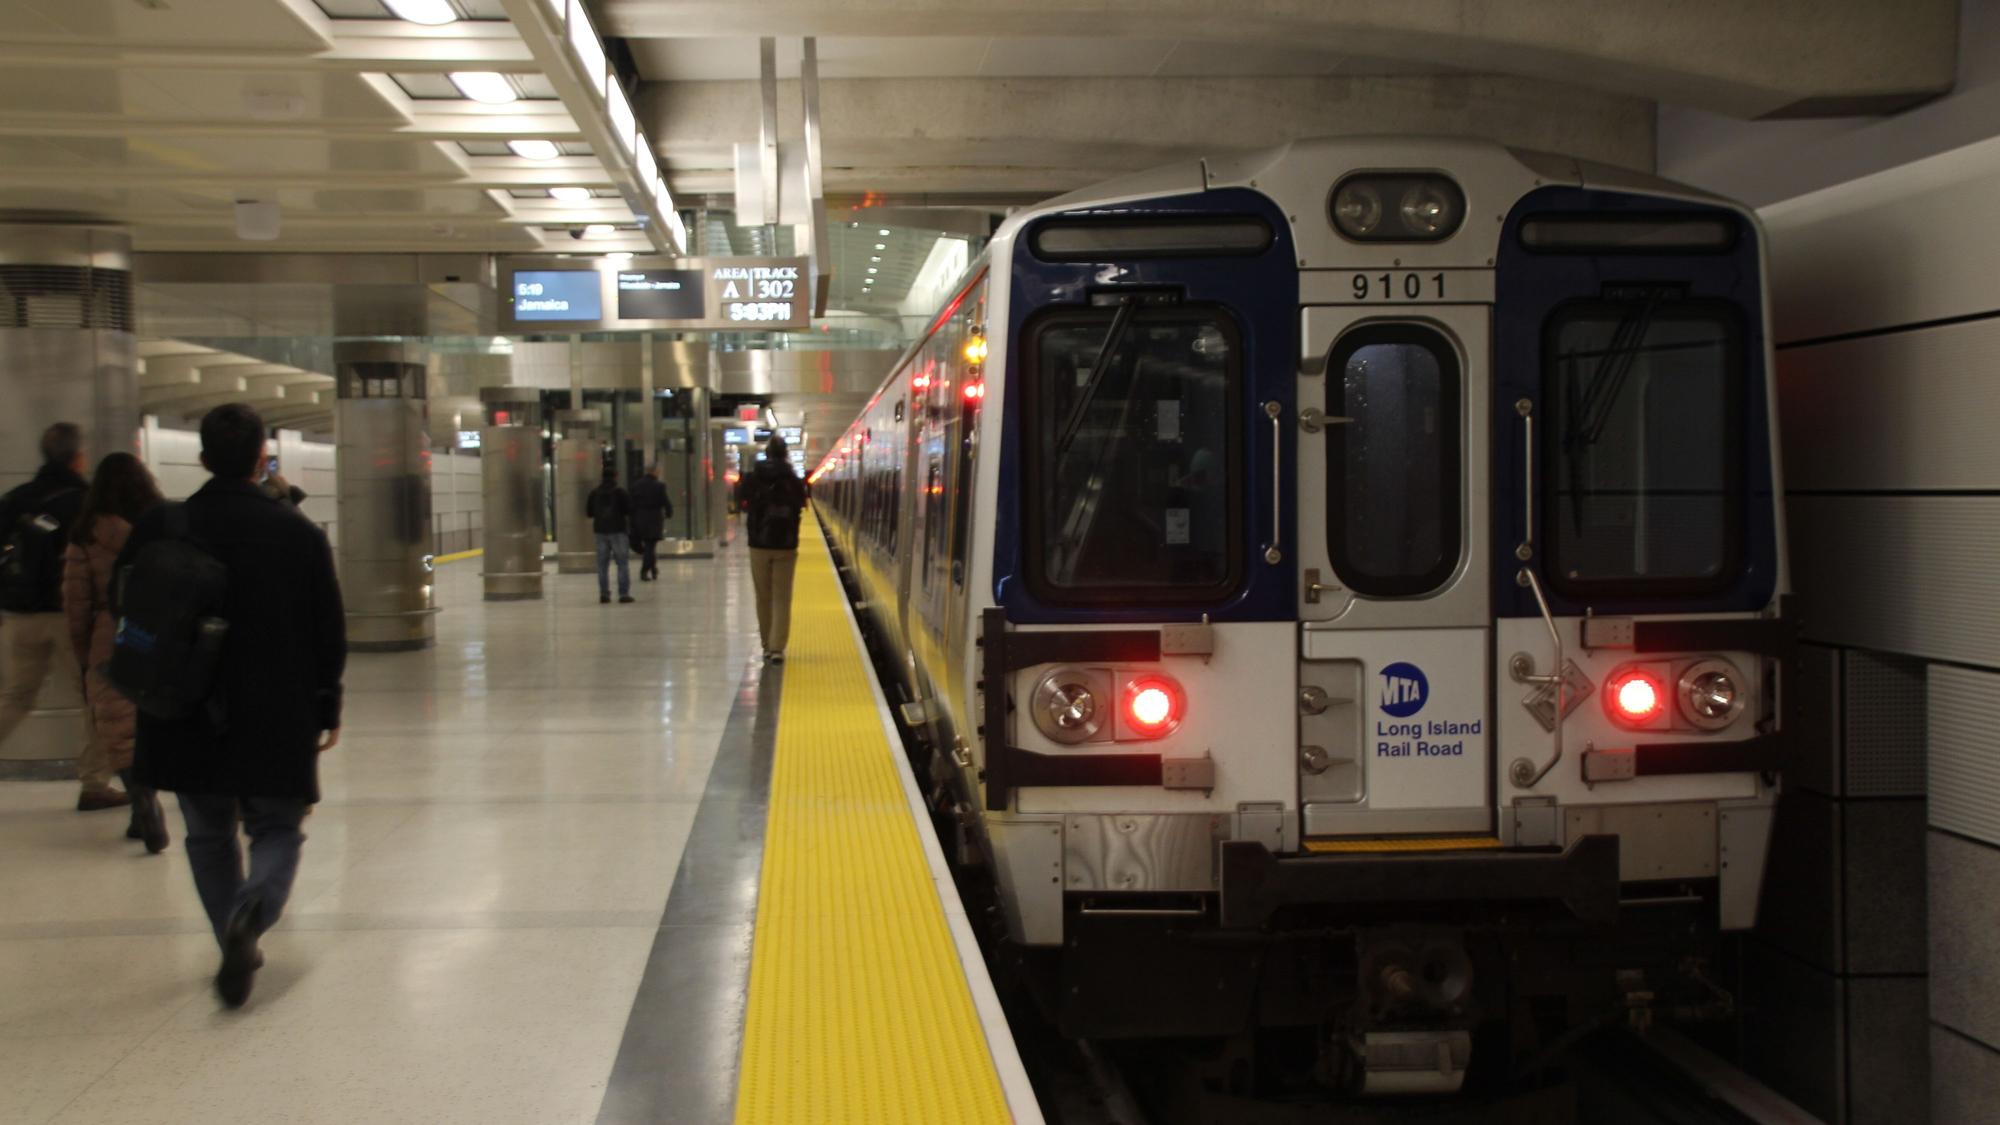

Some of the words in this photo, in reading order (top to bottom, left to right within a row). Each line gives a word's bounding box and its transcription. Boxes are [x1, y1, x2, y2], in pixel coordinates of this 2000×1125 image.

[714, 268, 748, 279] AREA
[753, 267, 799, 279] TRACK
[723, 280, 740, 298] A
[758, 280, 794, 298] 302
[1352, 273, 1445, 299] 9101
[518, 299, 569, 311] Jamaica
[1380, 674, 1420, 706] MTA
[1377, 721, 1422, 739] Long
[1428, 719, 1481, 735] Island
[1377, 742, 1411, 757] Rail
[1417, 740, 1463, 756] Road
